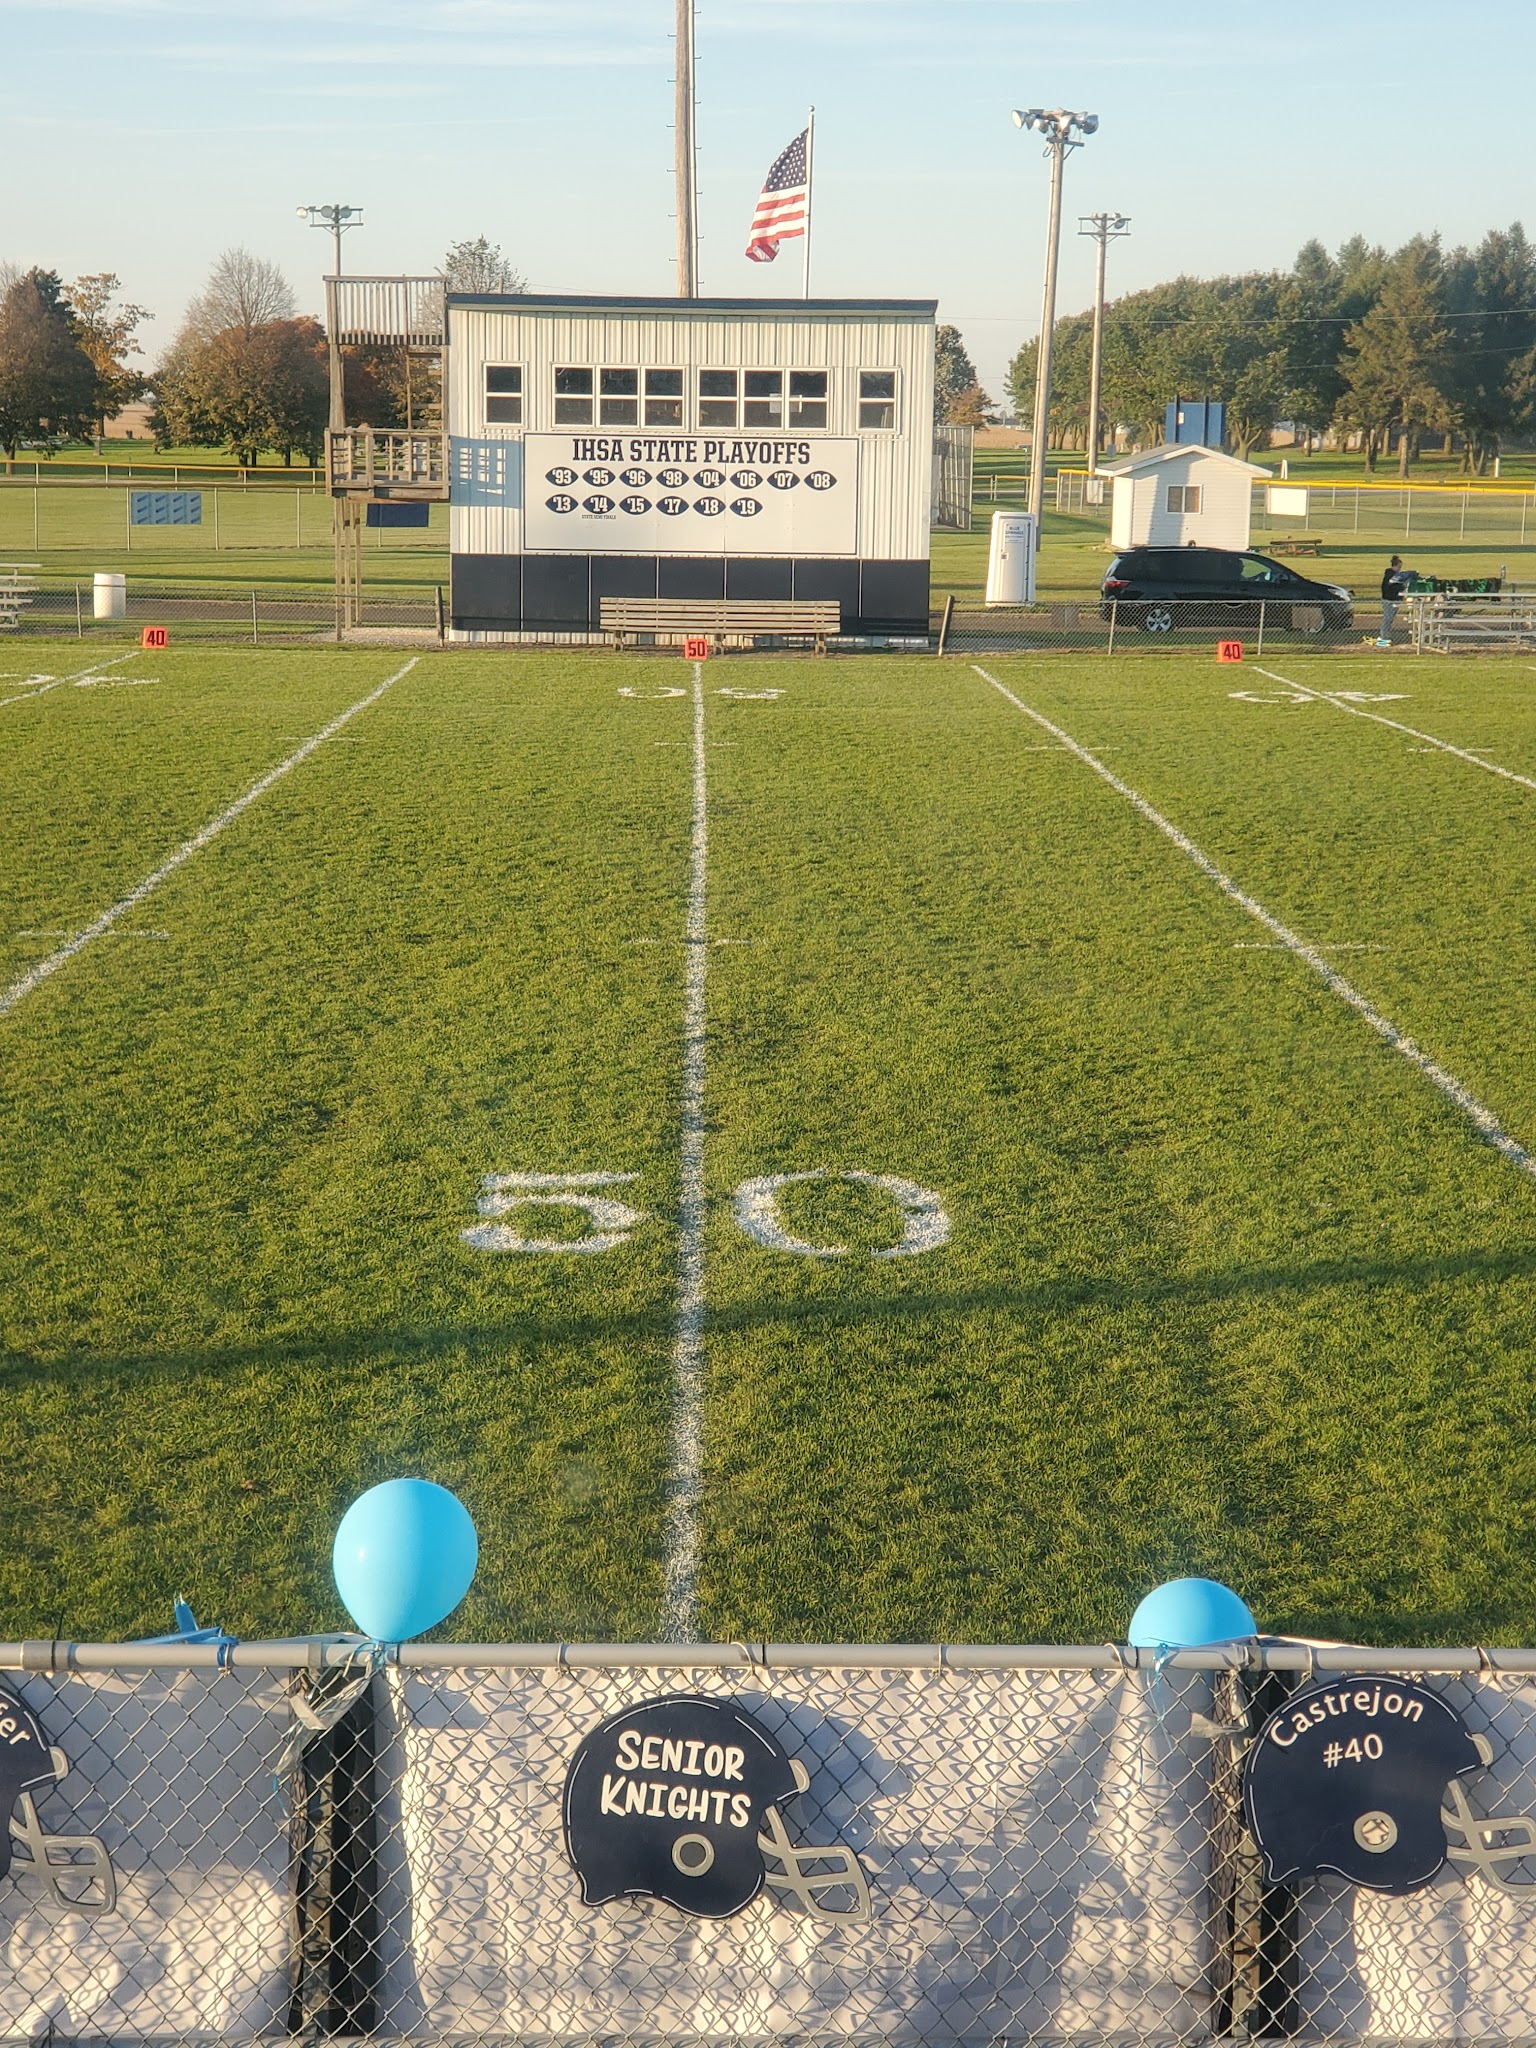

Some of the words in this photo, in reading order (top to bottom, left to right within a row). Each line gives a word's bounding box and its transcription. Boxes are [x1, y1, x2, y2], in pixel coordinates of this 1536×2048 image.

[573, 438, 624, 461] IHSA
[630, 439, 697, 463] STATE
[703, 440, 811, 465] PLAYOFFS
[146, 630, 165, 646] 40
[688, 641, 706, 657] 50
[1223, 643, 1241, 660] 40
[0, 1702, 31, 1745] er
[1269, 1686, 1425, 1748] Castrejon
[615, 1730, 745, 1782] SENIOR
[1322, 1733, 1384, 1769] #40
[601, 1774, 751, 1828] KNIGHTS
